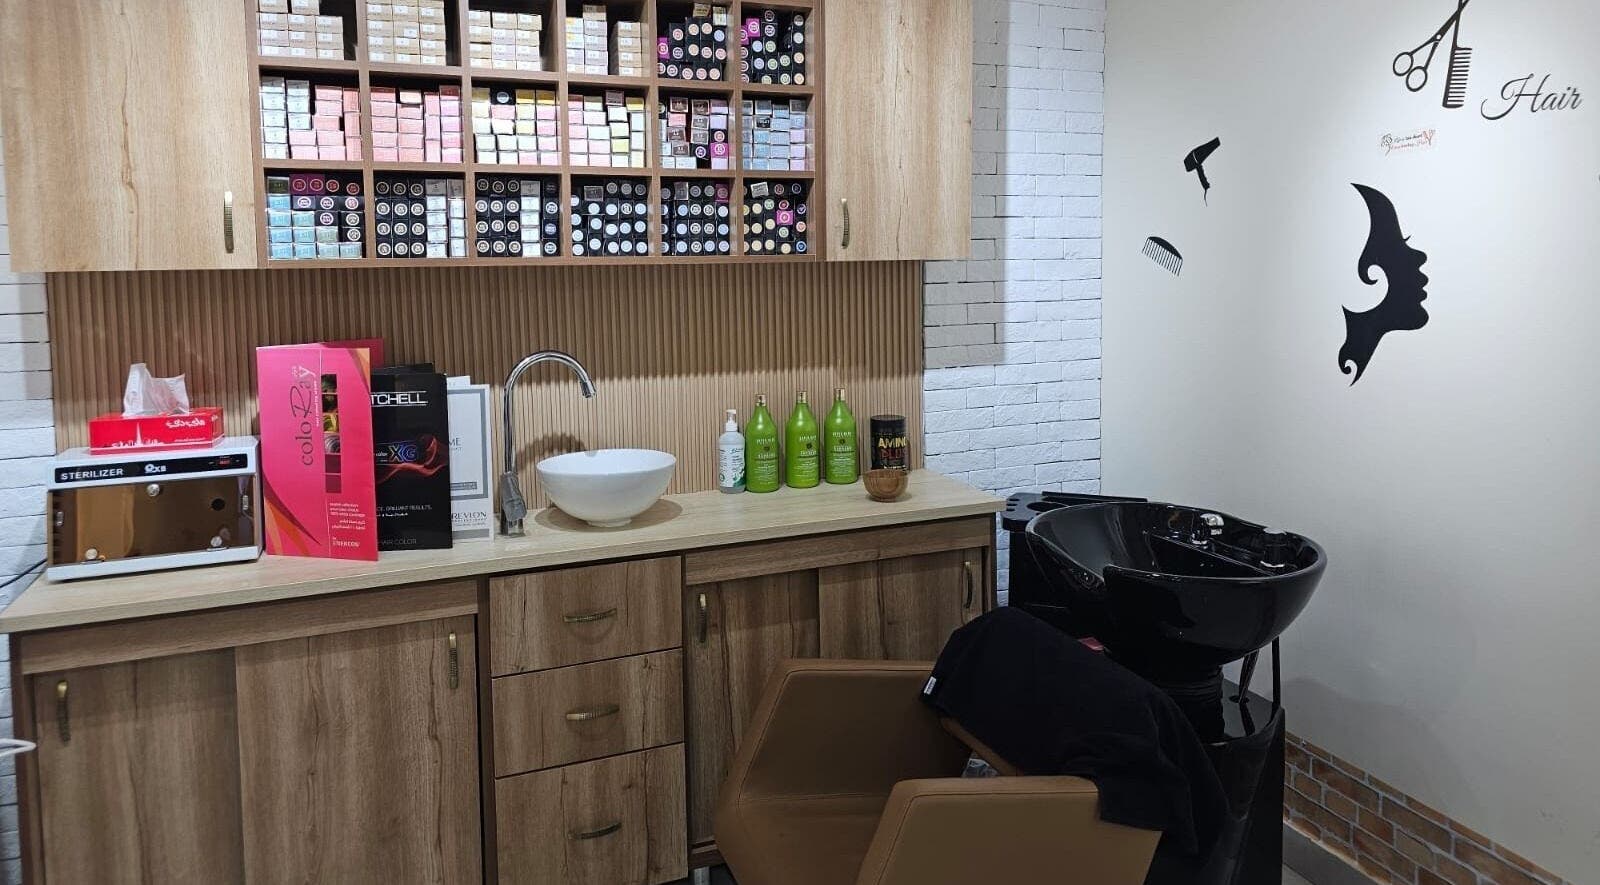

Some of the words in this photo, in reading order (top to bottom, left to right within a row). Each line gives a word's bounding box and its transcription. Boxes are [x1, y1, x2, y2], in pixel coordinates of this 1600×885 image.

[1480, 73, 1583, 120] Hair
[61, 468, 123, 480] STERILIZER
[451, 511, 487, 520] REVLON
